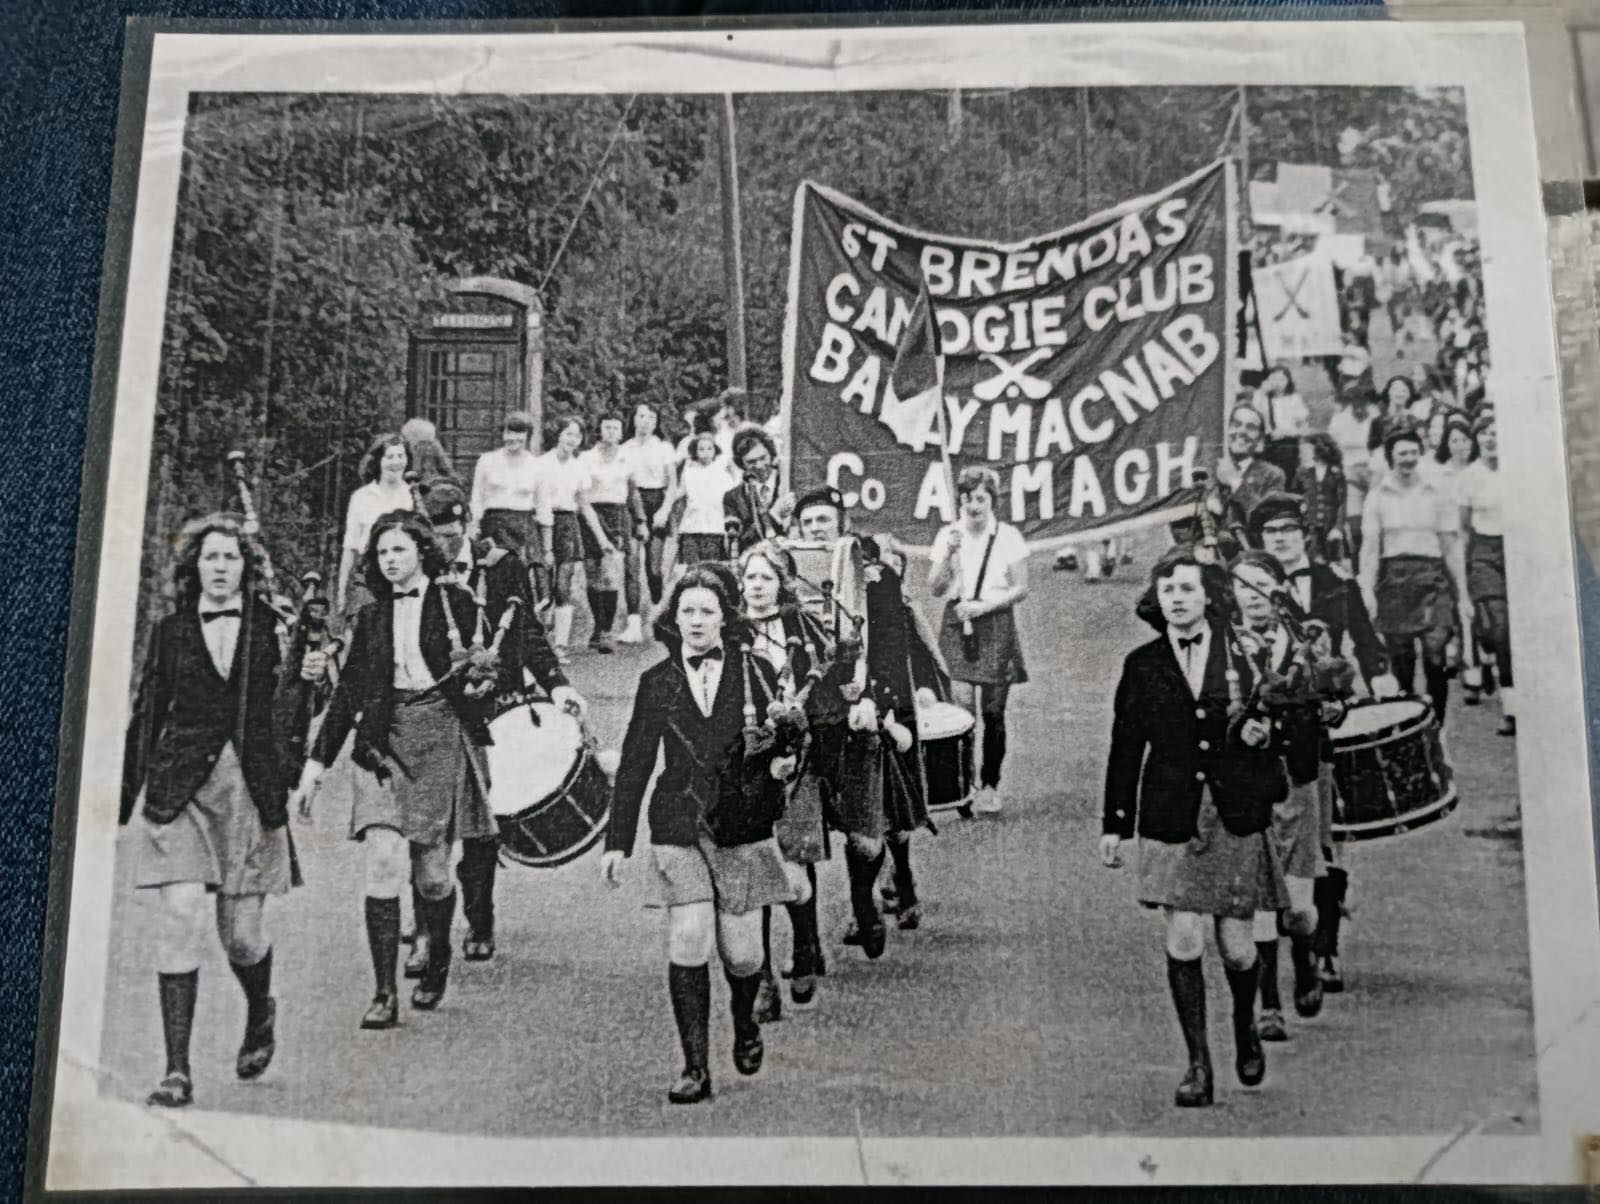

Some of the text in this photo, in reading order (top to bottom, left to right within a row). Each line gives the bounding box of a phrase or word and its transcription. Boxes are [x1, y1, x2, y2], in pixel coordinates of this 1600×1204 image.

[841, 199, 1188, 298] ST BRENDAS
[1082, 253, 1215, 331] CLUB
[809, 313, 1220, 462] BAYMACNAB
[913, 436, 1198, 522] AMAGH
